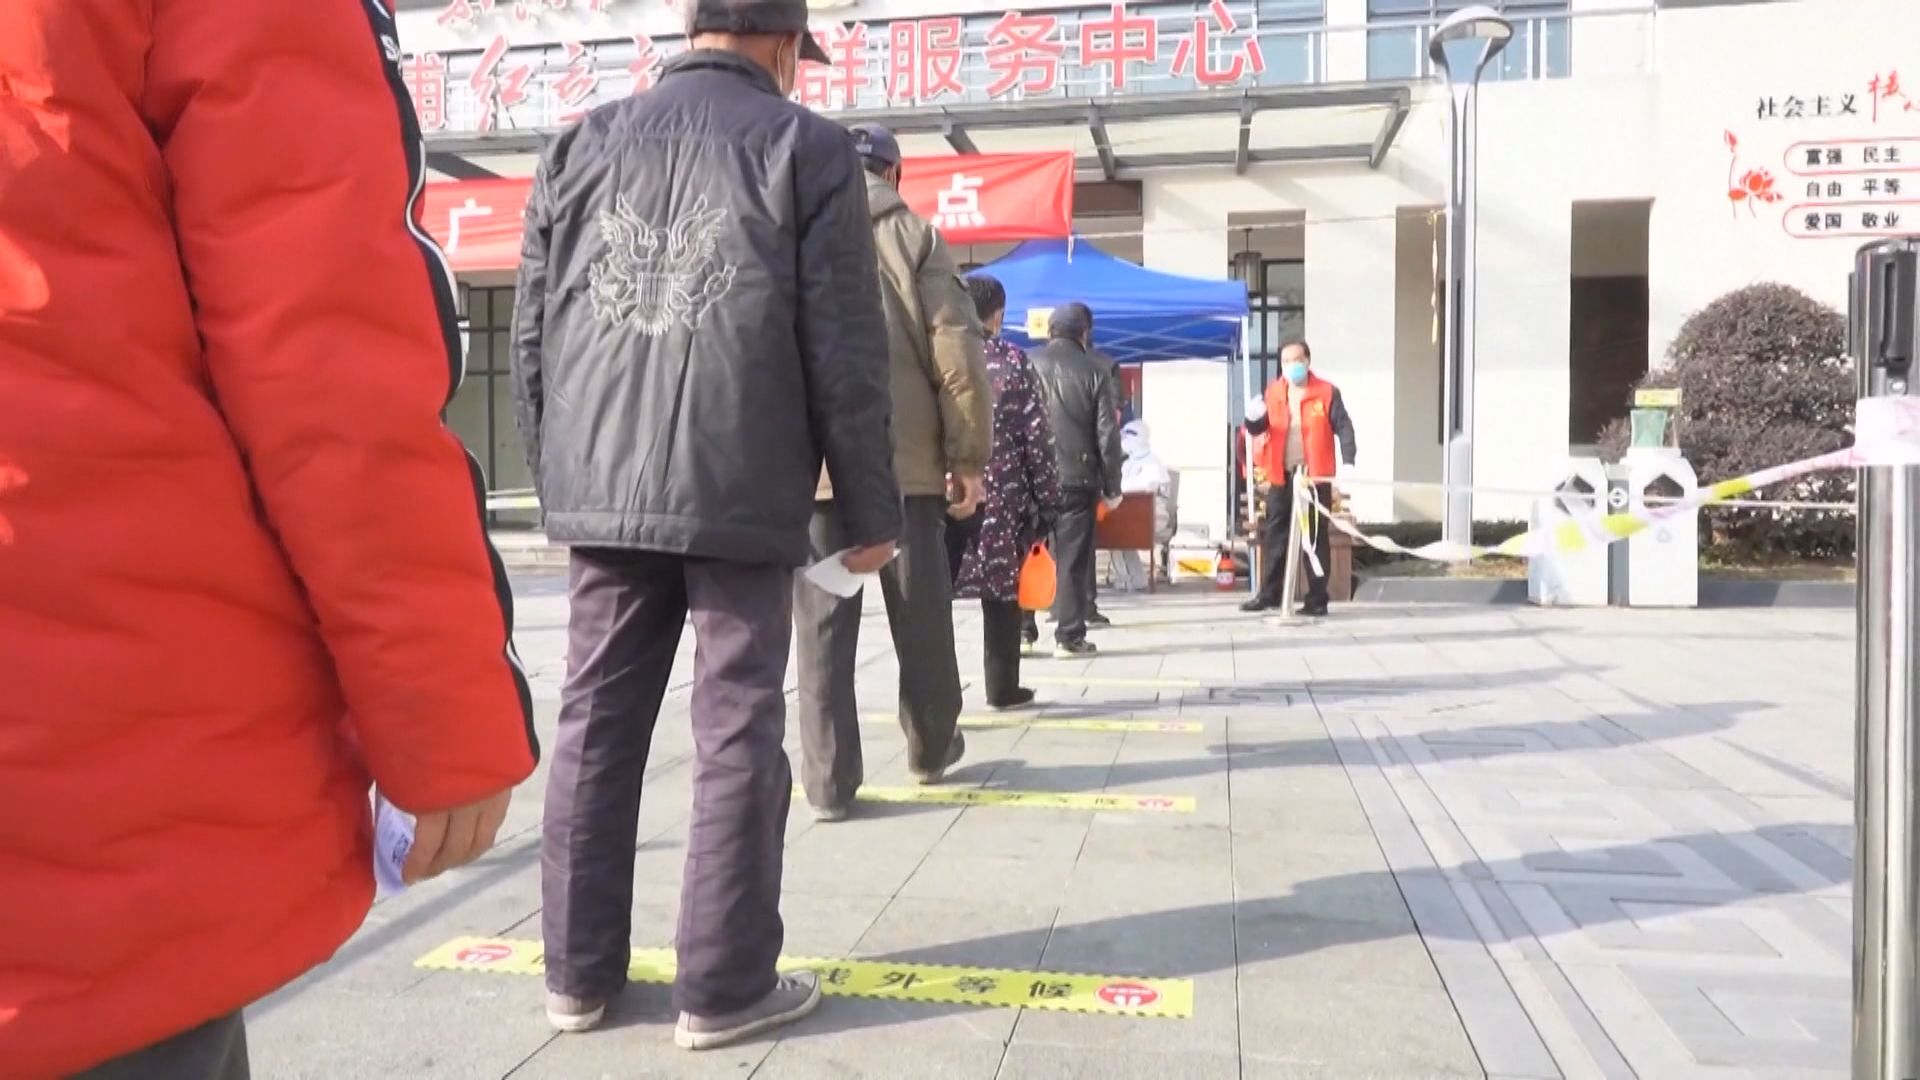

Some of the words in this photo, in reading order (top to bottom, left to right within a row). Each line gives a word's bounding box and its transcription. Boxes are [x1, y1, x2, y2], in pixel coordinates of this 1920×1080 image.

[1757, 93, 1857, 120] 社会主义
[1806, 148, 1842, 165] 富强
[1863, 146, 1900, 163] 民主
[1806, 180, 1842, 197] 自由
[1862, 178, 1900, 196] 平等
[930, 172, 987, 229] 点
[1804, 212, 1842, 230] 爱国
[1862, 211, 1900, 229] 敬业
